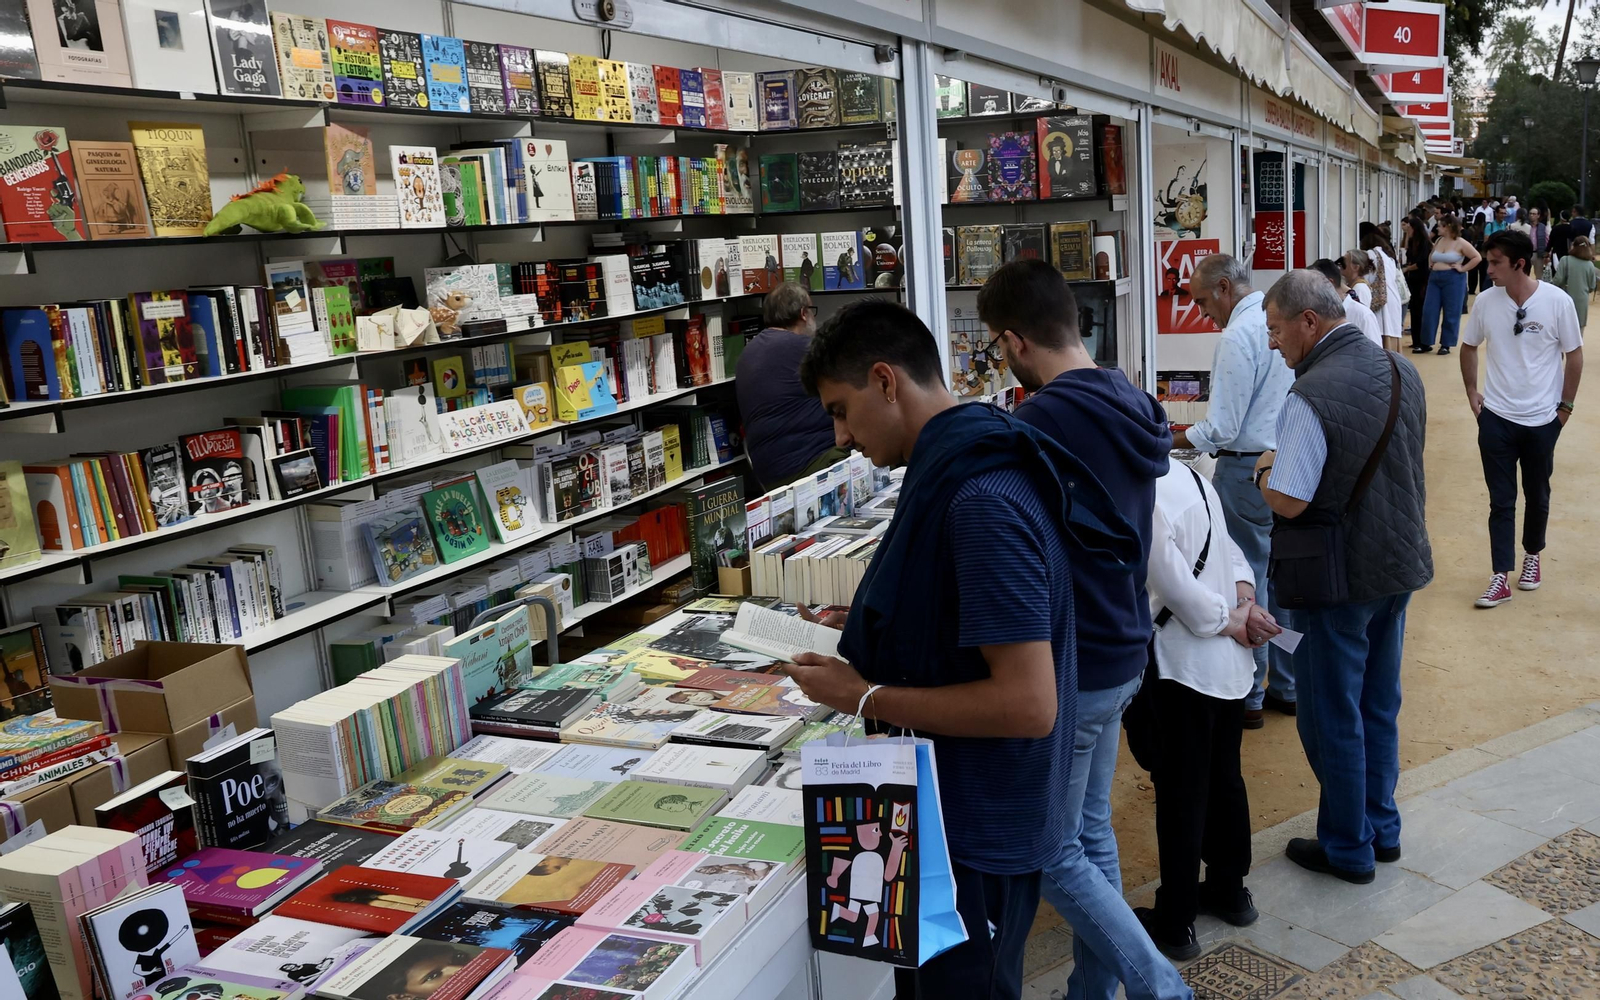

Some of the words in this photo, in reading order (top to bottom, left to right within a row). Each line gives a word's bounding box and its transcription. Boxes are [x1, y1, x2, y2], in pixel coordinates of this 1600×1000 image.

[1393, 26, 1411, 43] 40
[230, 54, 263, 73] Lady
[1159, 51, 1181, 92] AKAL
[233, 69, 267, 87] Gaga
[1411, 72, 1421, 85] 41
[798, 91, 834, 102] LOVECRAFT
[145, 129, 193, 142] TIQQUN
[0, 148, 44, 176] BANDIDOS
[3, 160, 50, 187] GENEROSOS
[742, 237, 771, 245] SHERLOCK
[783, 236, 811, 244] SHERLOCK
[783, 242, 812, 252] HOLMES
[822, 234, 850, 242] SHERLOCK
[823, 241, 851, 250] HOLMES
[742, 244, 771, 253] HOLMES
[966, 245, 992, 253] Dalloway
[459, 417, 470, 427] EL
[459, 427, 477, 438] LOS
[478, 418, 516, 434] JUGUETES
[702, 500, 706, 512] I
[707, 489, 739, 511] GUERRA
[703, 503, 740, 527] MUNDIAL
[14, 744, 53, 765] FUNCIONAN
[52, 739, 66, 751] LAS
[66, 731, 89, 745] COSAS
[1, 762, 41, 779] CHINA
[50, 753, 71, 762] MEJORES
[14, 783, 25, 791] LIBRO
[38, 758, 84, 783] ANIMALES
[814, 766, 829, 776] 83
[831, 761, 850, 770] Feria
[850, 761, 862, 769] del
[862, 760, 882, 769] Libro
[840, 768, 861, 776] Madrid
[220, 772, 265, 816] Poe
[504, 777, 541, 803] Cuarenta
[518, 781, 548, 803] poemas
[227, 820, 236, 829] no
[236, 813, 245, 825] ha
[245, 802, 267, 819] muerto
[708, 821, 737, 848] secreto
[724, 824, 750, 845] haiku
[398, 857, 416, 869] DEL
[414, 839, 441, 857] ROCK
[256, 945, 270, 954] YA
[267, 930, 311, 957] HABLAREMOS
[278, 951, 294, 959] DE
[286, 940, 310, 953] NADA
